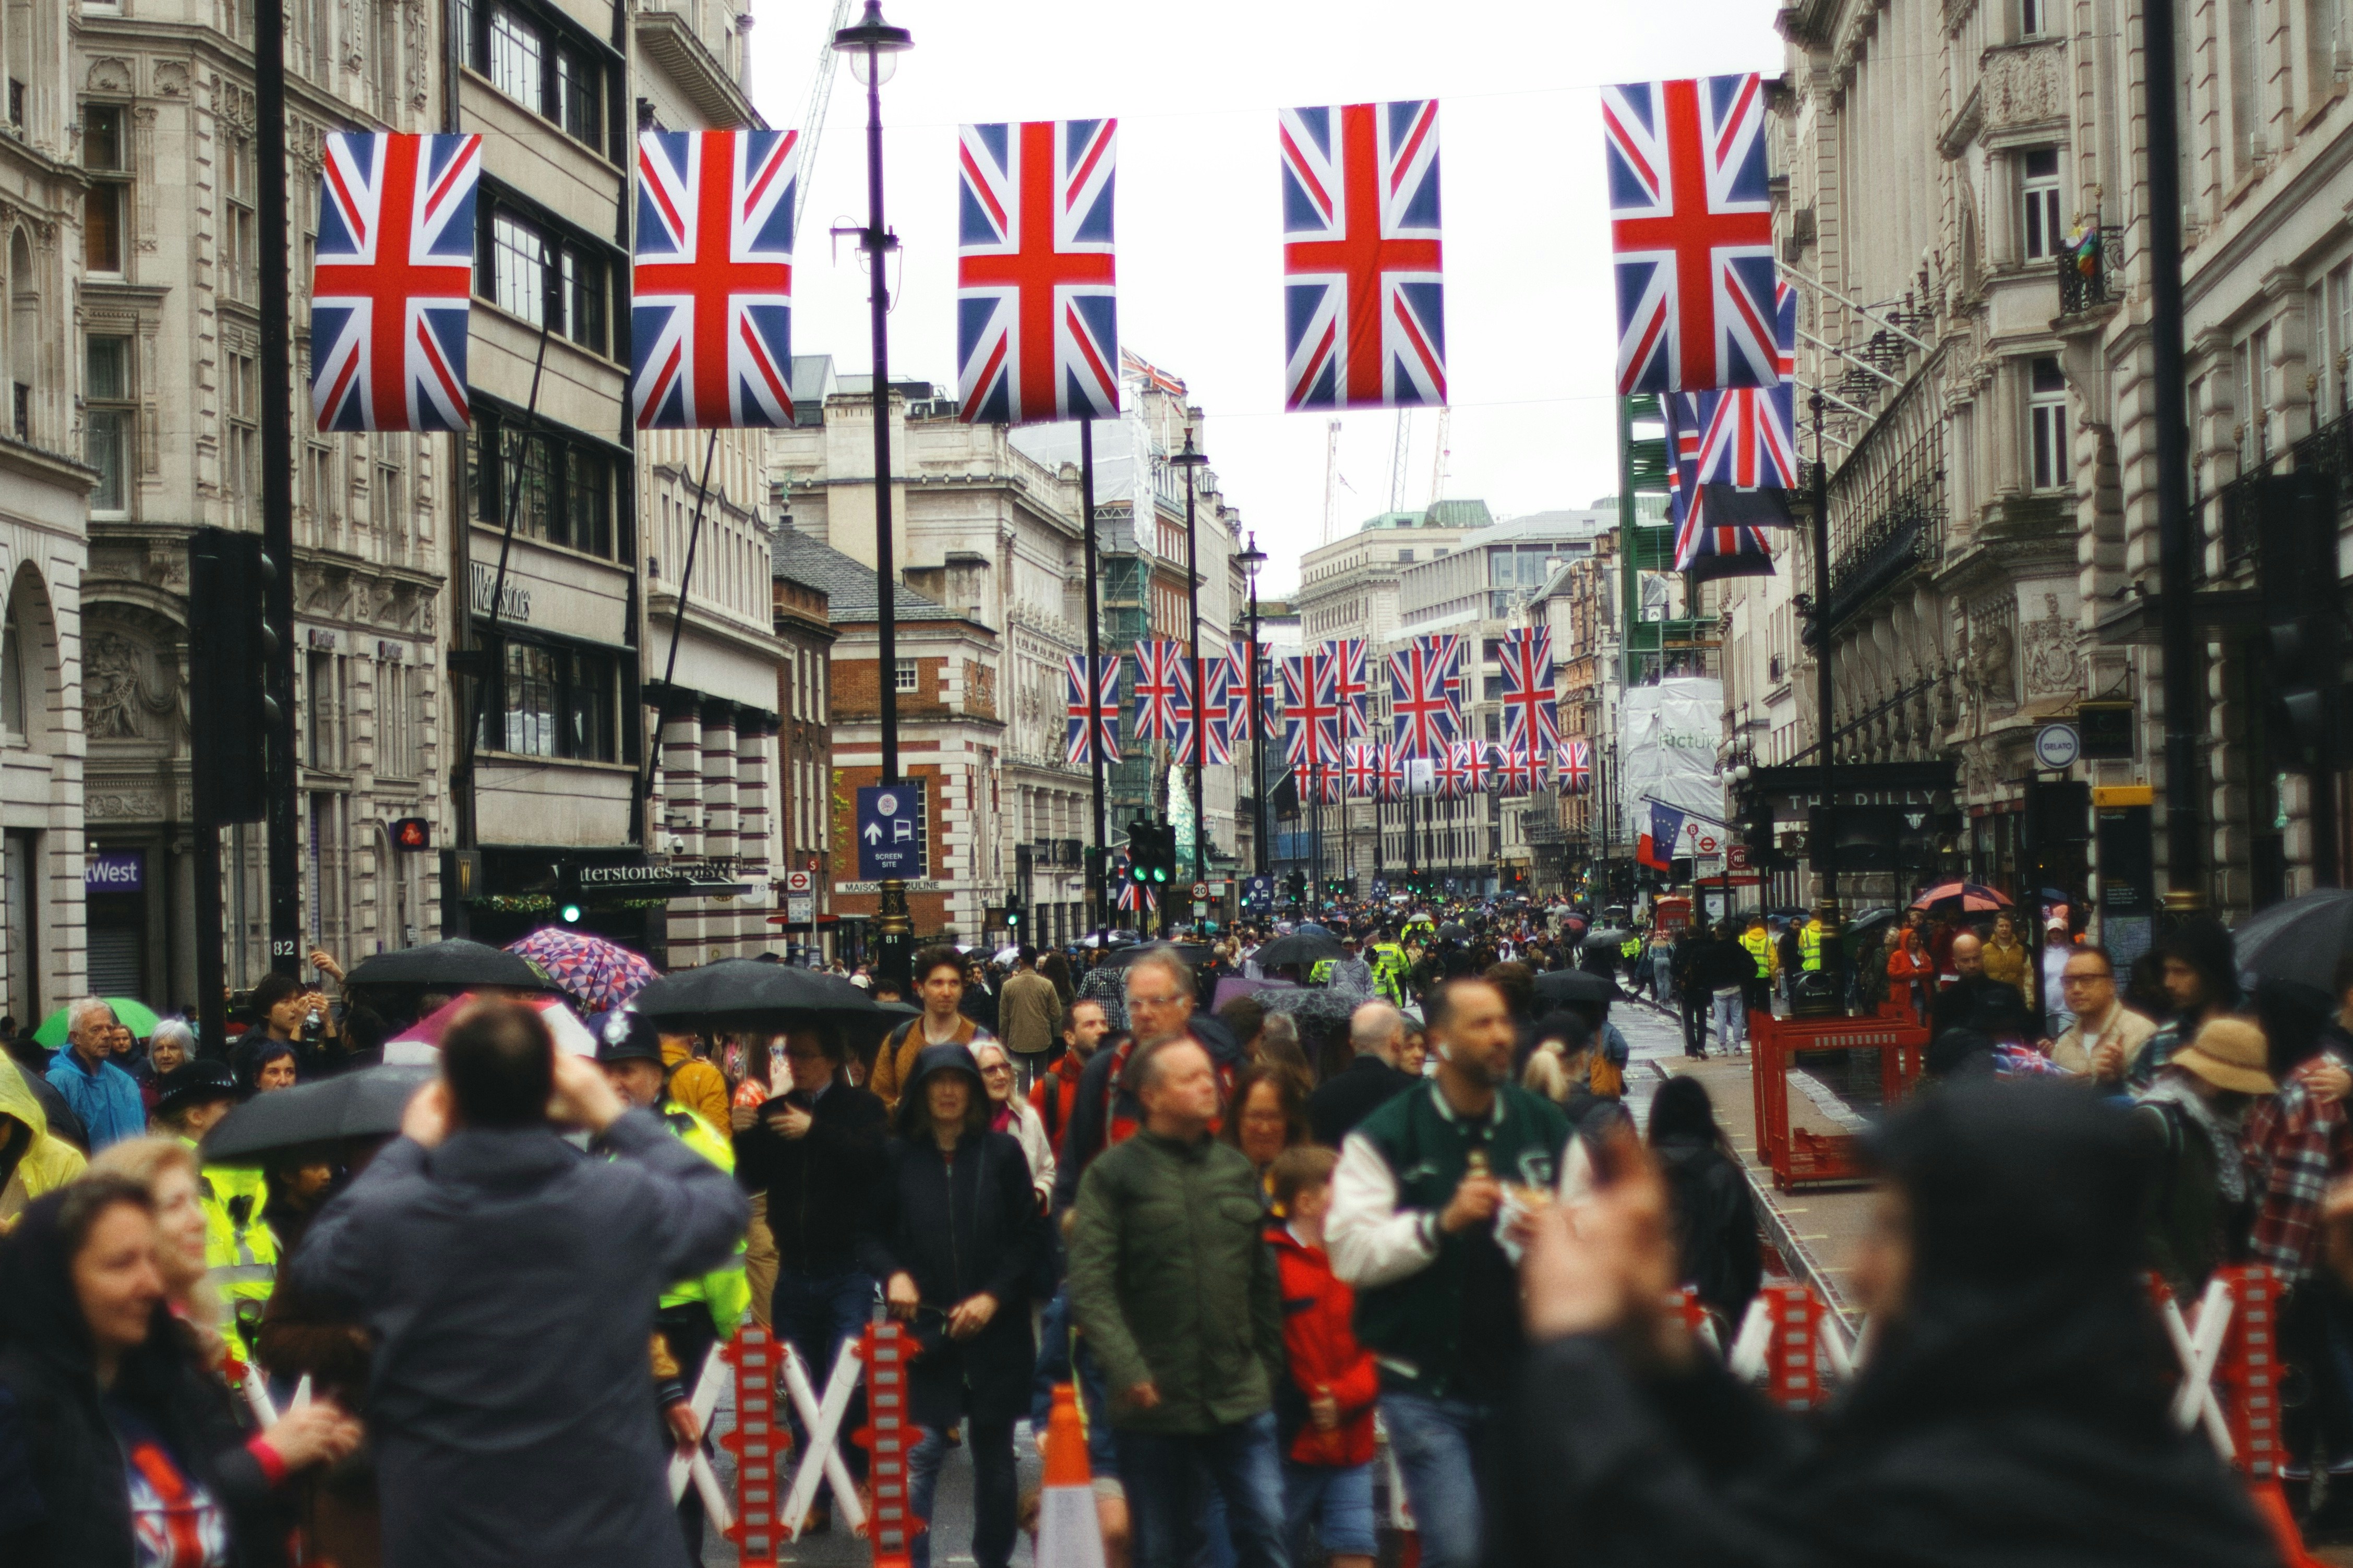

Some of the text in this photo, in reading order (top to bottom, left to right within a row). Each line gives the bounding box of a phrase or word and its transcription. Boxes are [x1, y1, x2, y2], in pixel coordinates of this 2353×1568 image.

[471, 563, 530, 621] Watstones
[1855, 789, 1936, 805] DILLY
[1690, 826, 1696, 834] B
[85, 861, 137, 883] tWest
[551, 864, 673, 882] terstones
[810, 861, 816, 871] S
[905, 882, 939, 890] OULINE
[886, 935, 898, 944] 81
[273, 941, 294, 956] 82
